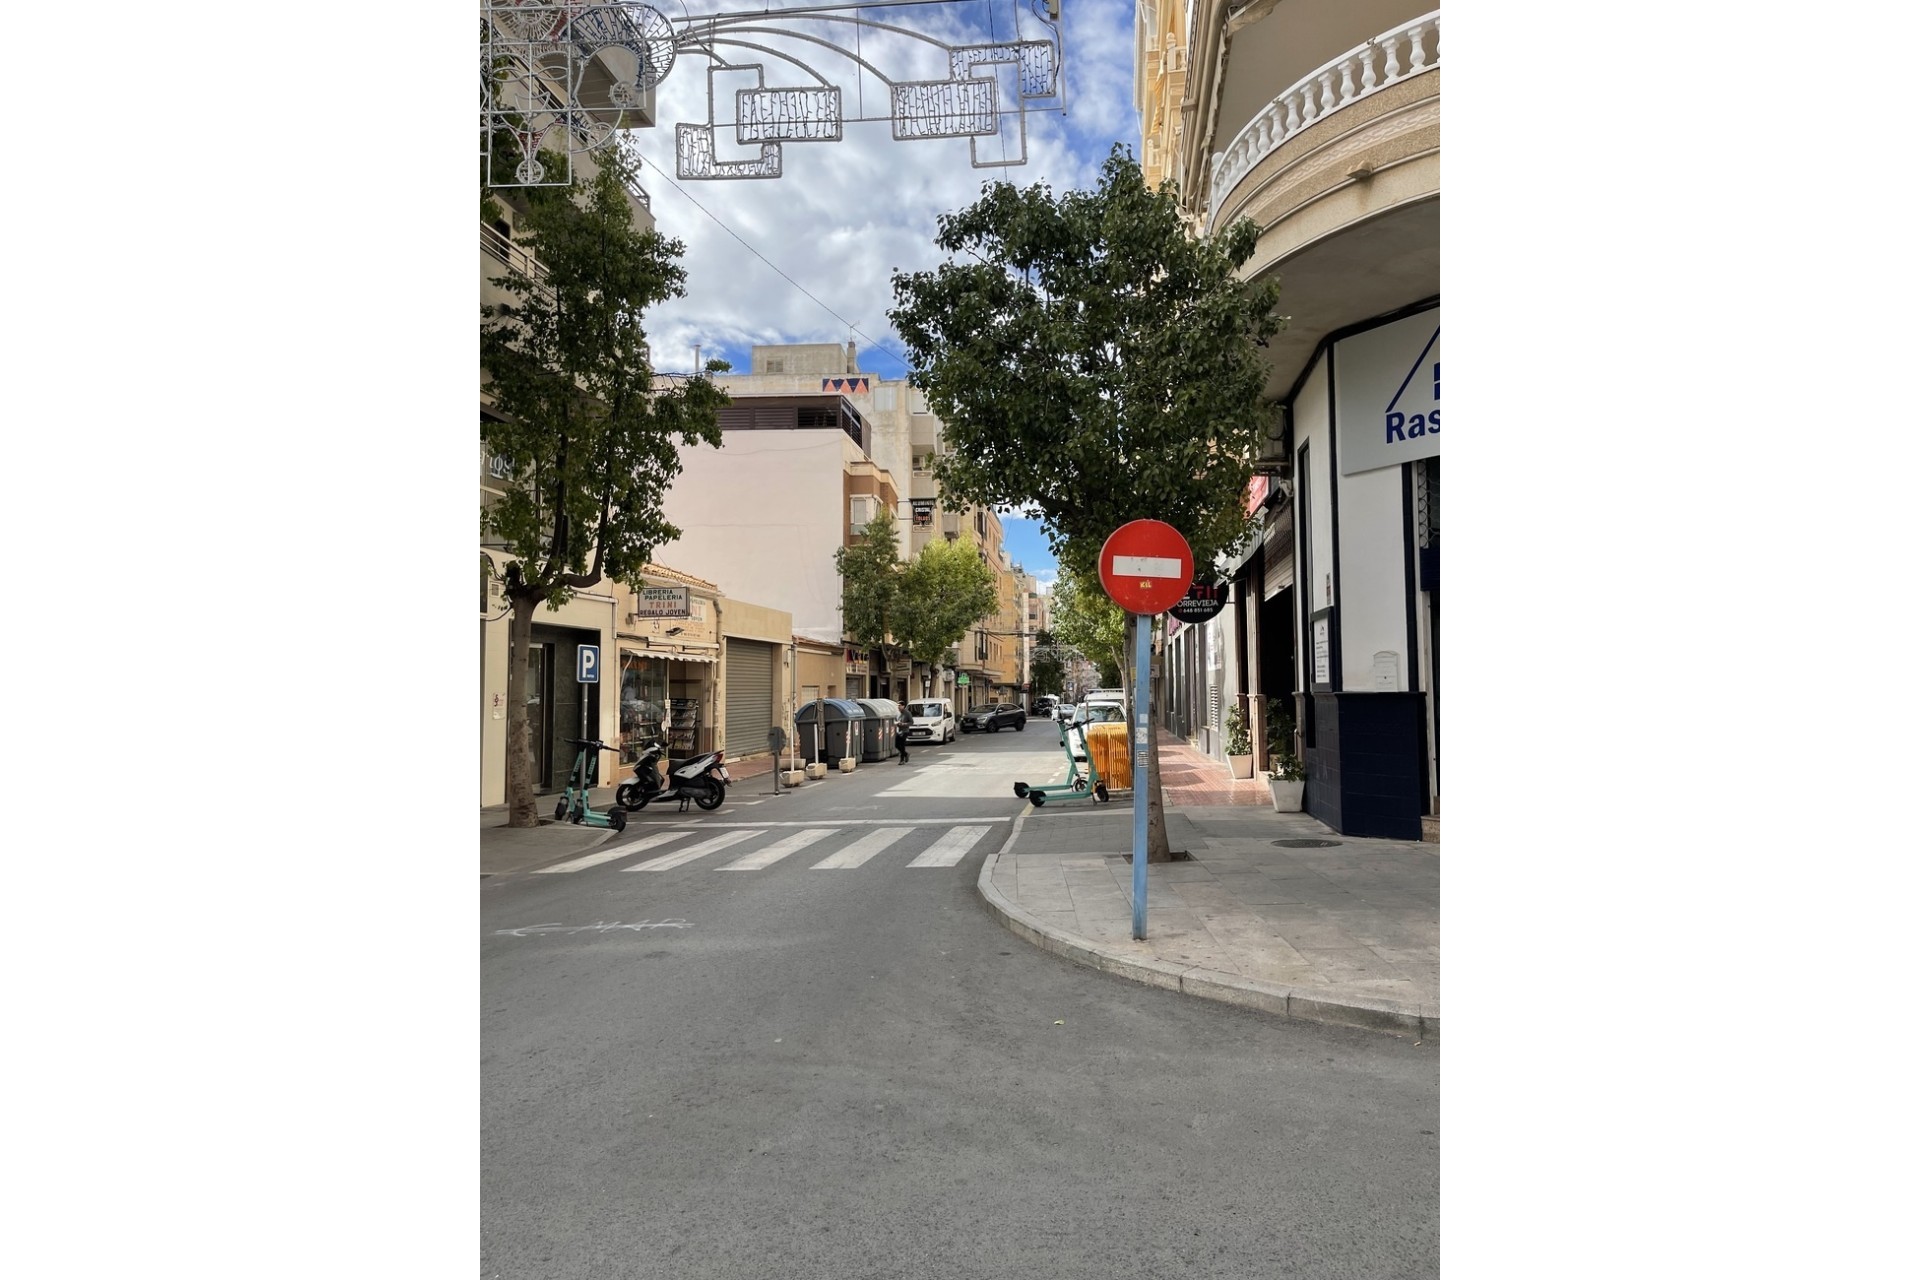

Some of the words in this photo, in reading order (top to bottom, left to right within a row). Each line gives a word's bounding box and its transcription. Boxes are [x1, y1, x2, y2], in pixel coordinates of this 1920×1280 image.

[1386, 409, 1440, 444] Ras
[1177, 599, 1218, 607] ORREVIEJA
[582, 650, 595, 678] P
